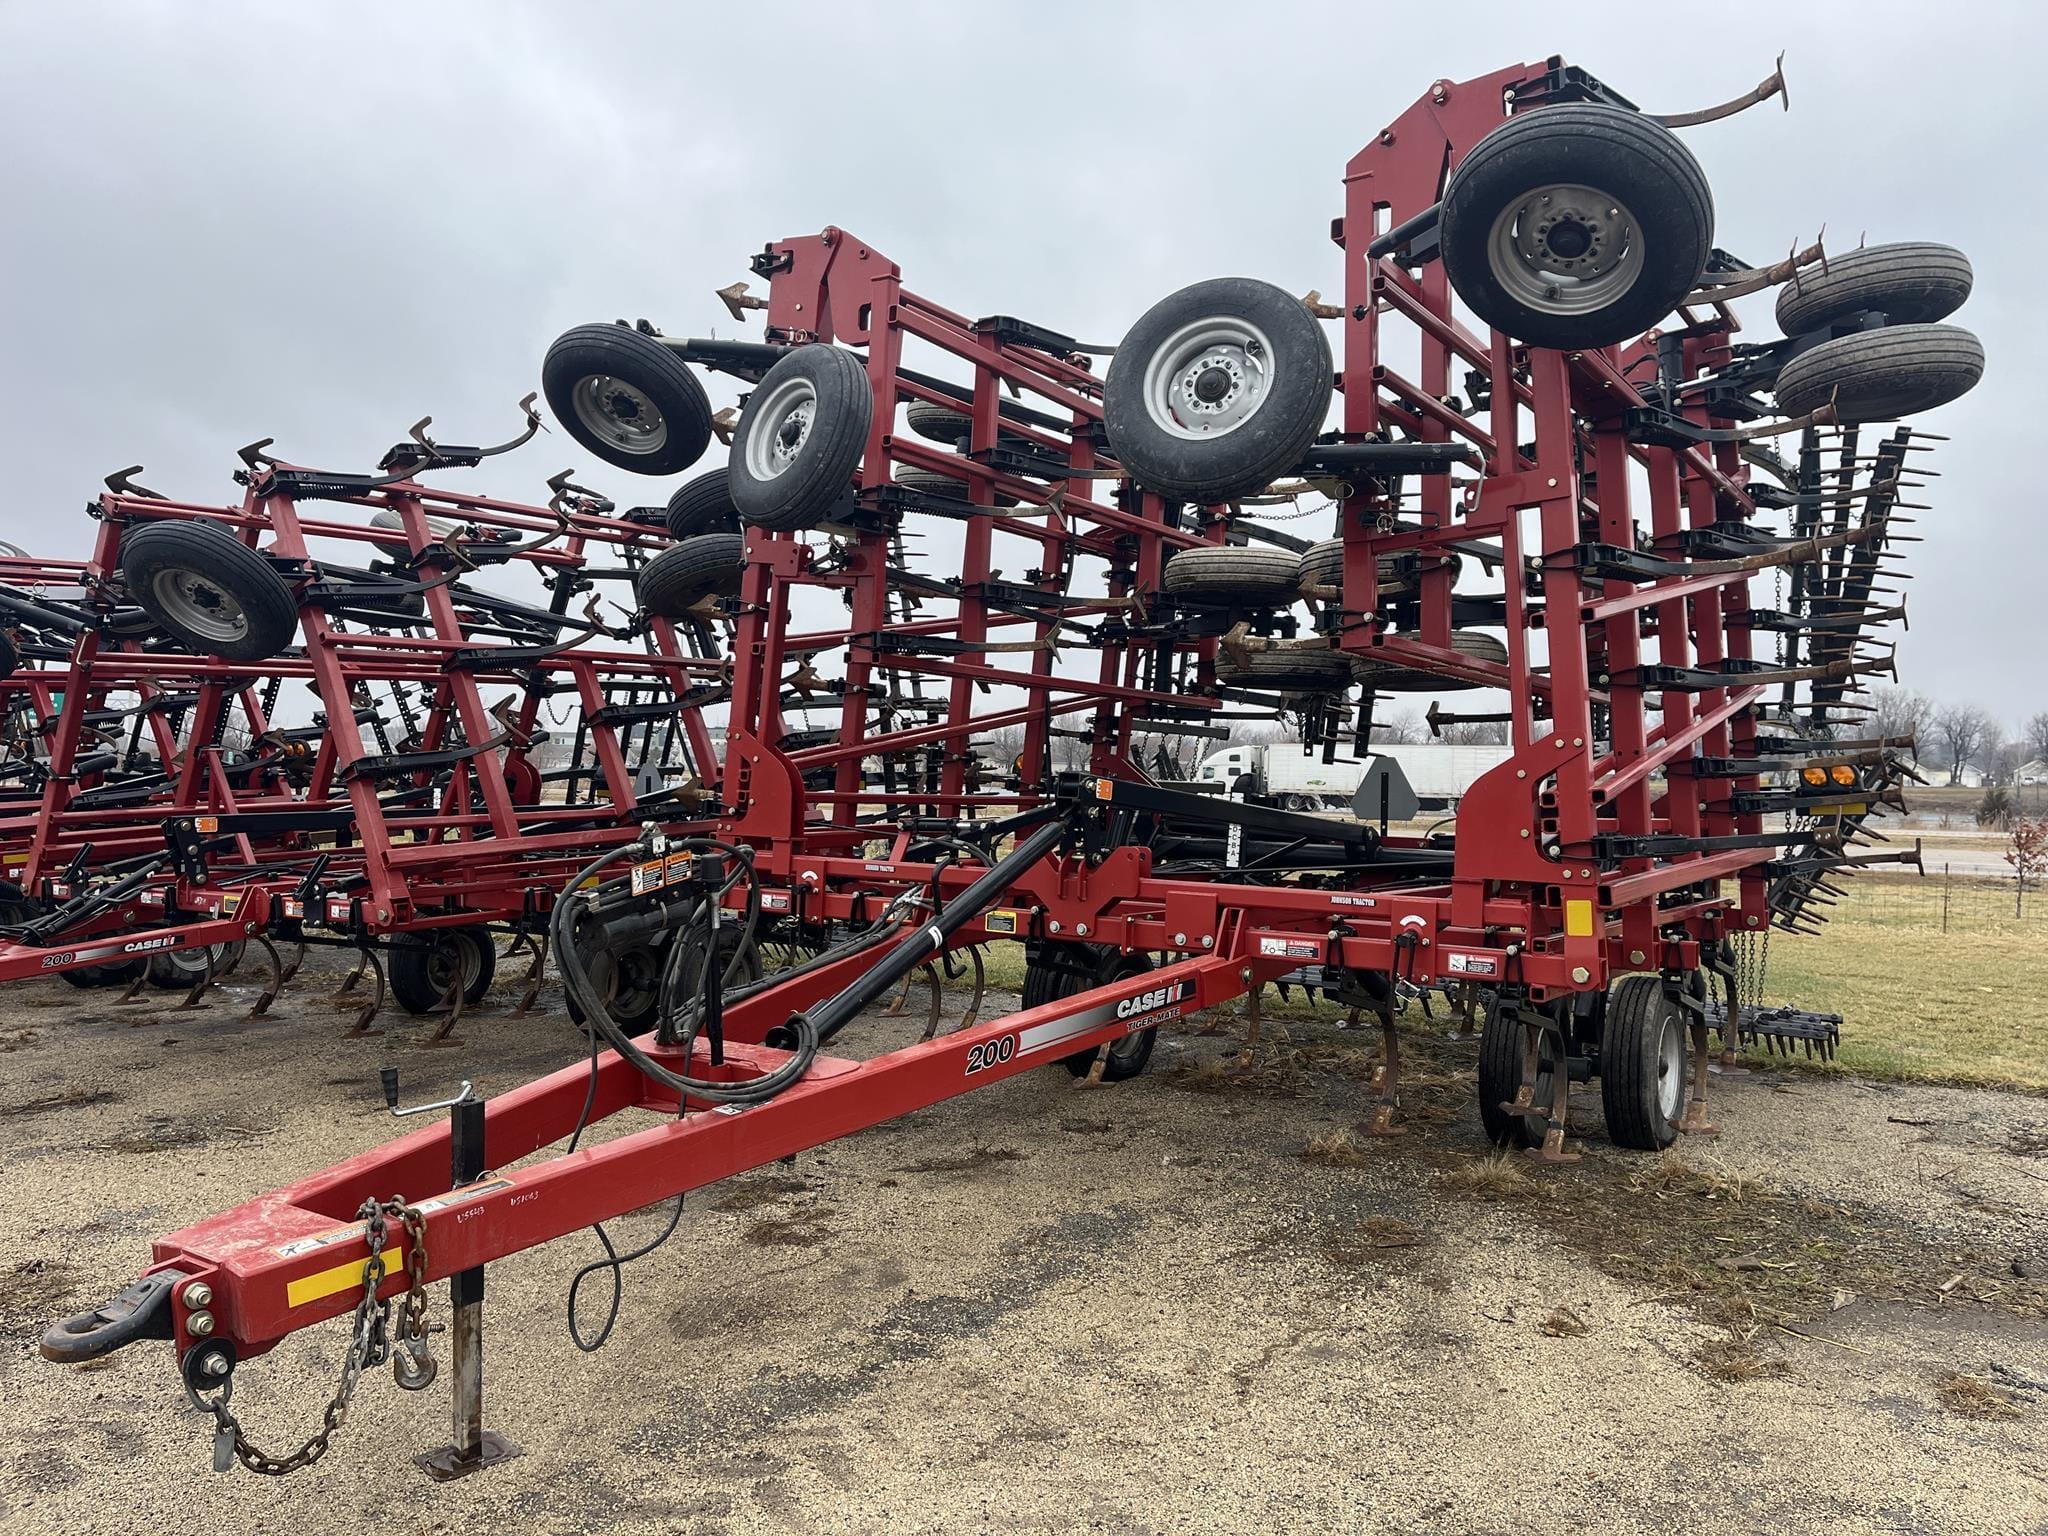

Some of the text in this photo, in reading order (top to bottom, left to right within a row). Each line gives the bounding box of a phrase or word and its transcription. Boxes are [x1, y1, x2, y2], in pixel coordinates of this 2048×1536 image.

[1331, 895, 1375, 906] JOHNSON TRACTOR
[124, 939, 162, 952] CASE
[42, 952, 72, 968] 200
[1117, 988, 1166, 1019] CASE
[1127, 1006, 1180, 1032] TIGER-MATE
[965, 1034, 1015, 1076] 200
